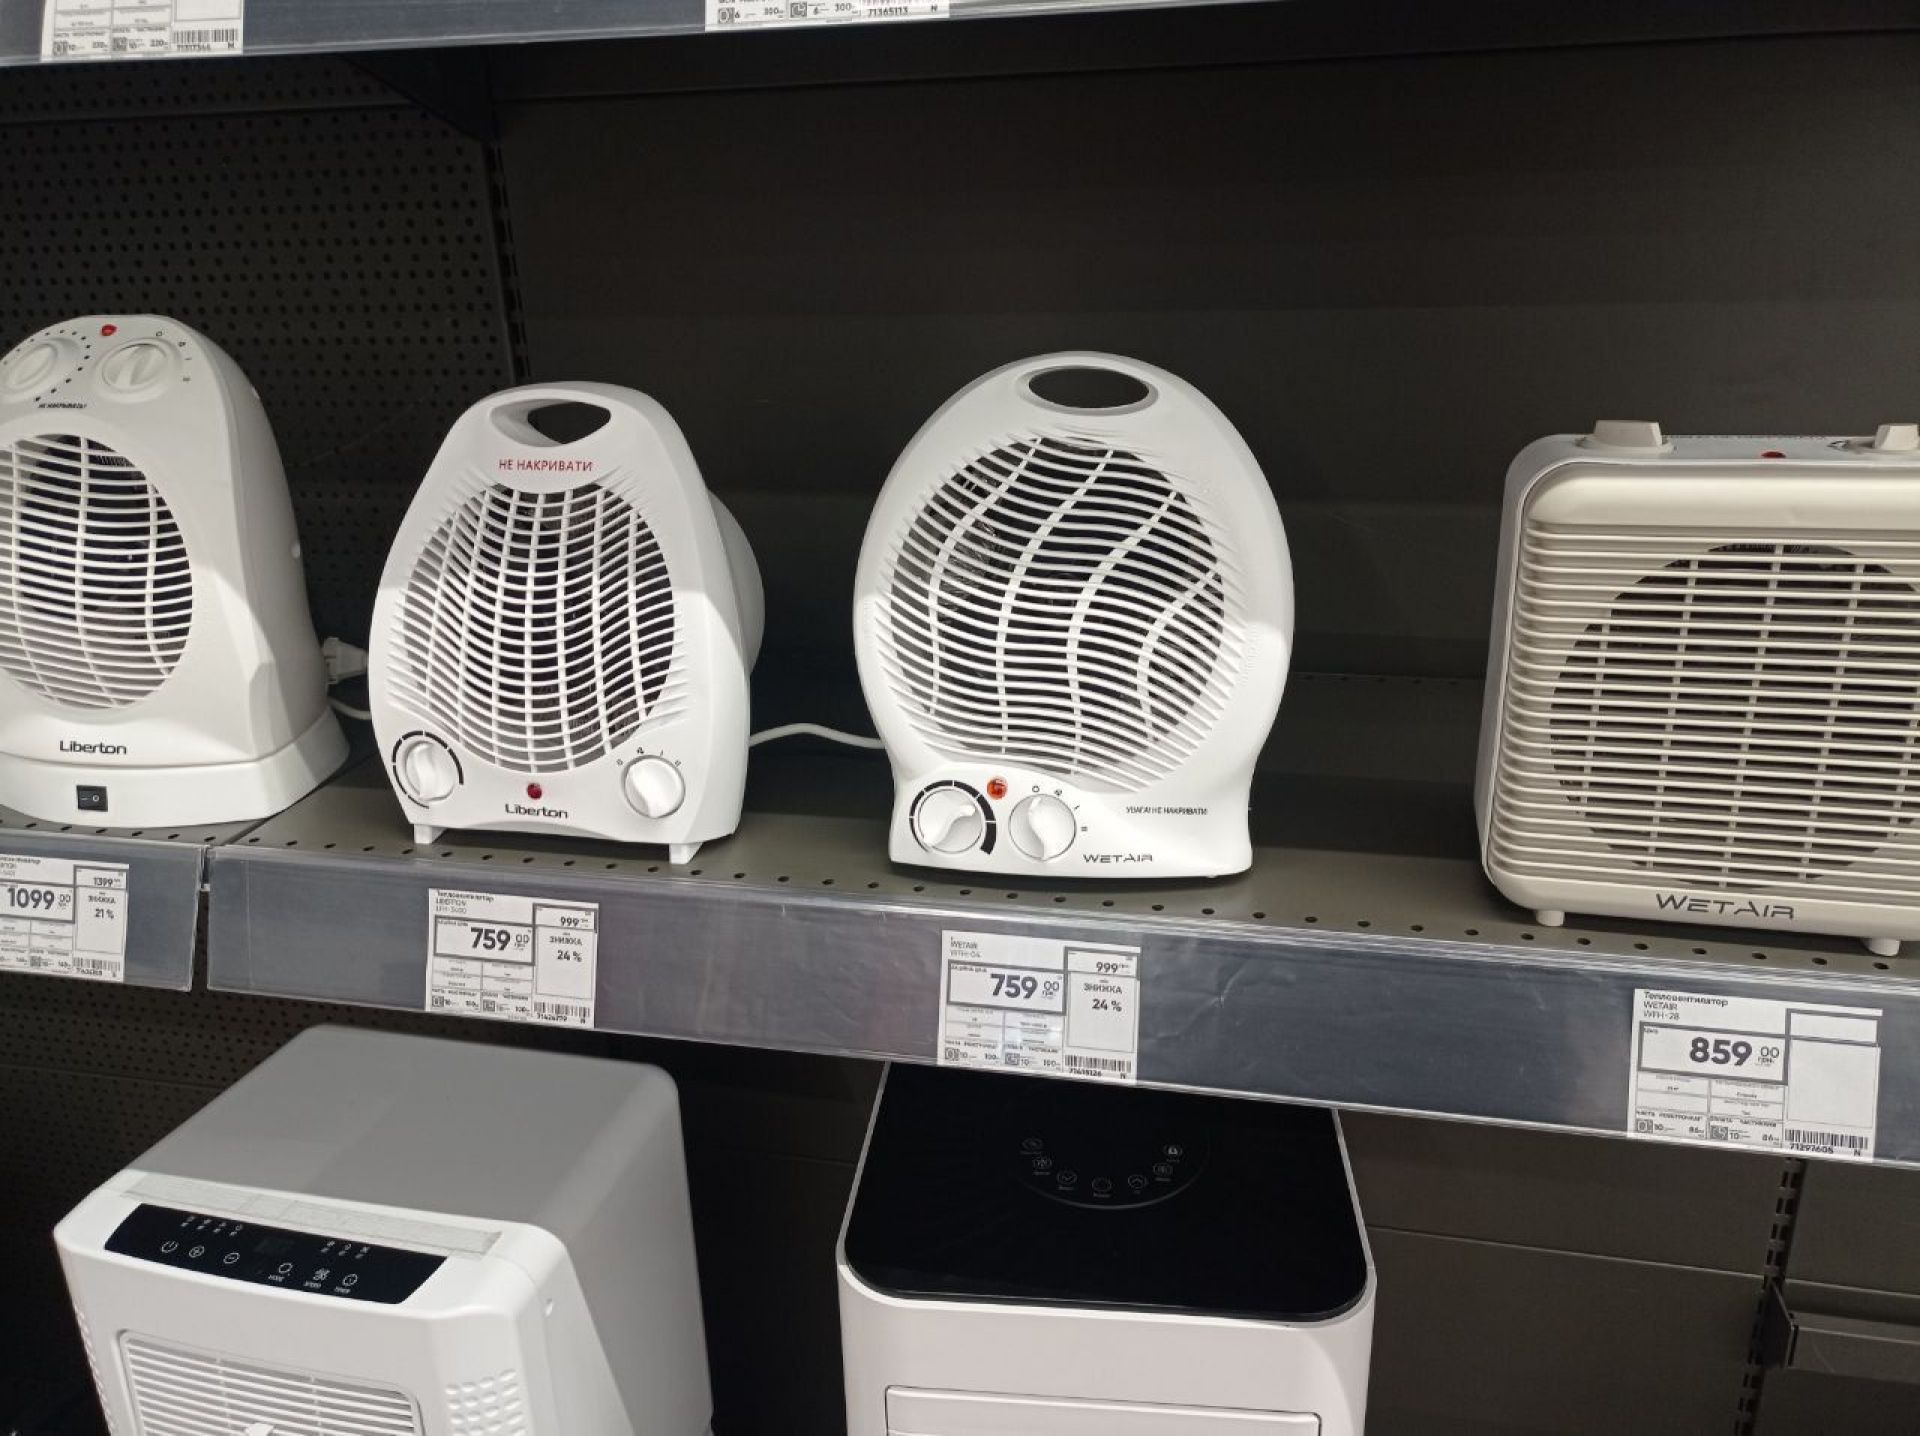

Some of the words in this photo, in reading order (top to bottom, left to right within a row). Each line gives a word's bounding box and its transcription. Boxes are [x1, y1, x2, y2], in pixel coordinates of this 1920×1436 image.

[499, 459, 514, 470] НЕ
[517, 459, 593, 472] НАКРИВАТИ
[60, 740, 127, 754] Liberton
[505, 803, 568, 818] Liberton
[1083, 854, 1153, 864] WETAIR
[8, 888, 55, 910] 1099
[1656, 893, 1794, 920] WETAIR
[95, 908, 104, 918] 21
[560, 916, 579, 926] 999
[470, 927, 510, 951] 759
[516, 934, 530, 944] 00
[550, 936, 582, 946] ЗНИЖКА
[557, 950, 570, 961] 24
[572, 951, 582, 962] %
[1096, 962, 1118, 973] 999
[990, 972, 1038, 999] 759
[1044, 980, 1060, 992] 00
[1084, 982, 1122, 994] ЗНИЖКА
[1092, 998, 1108, 1011] 24
[1112, 1000, 1122, 1012] %
[1690, 1036, 1752, 1066] 859
[1760, 1046, 1780, 1058] 00
